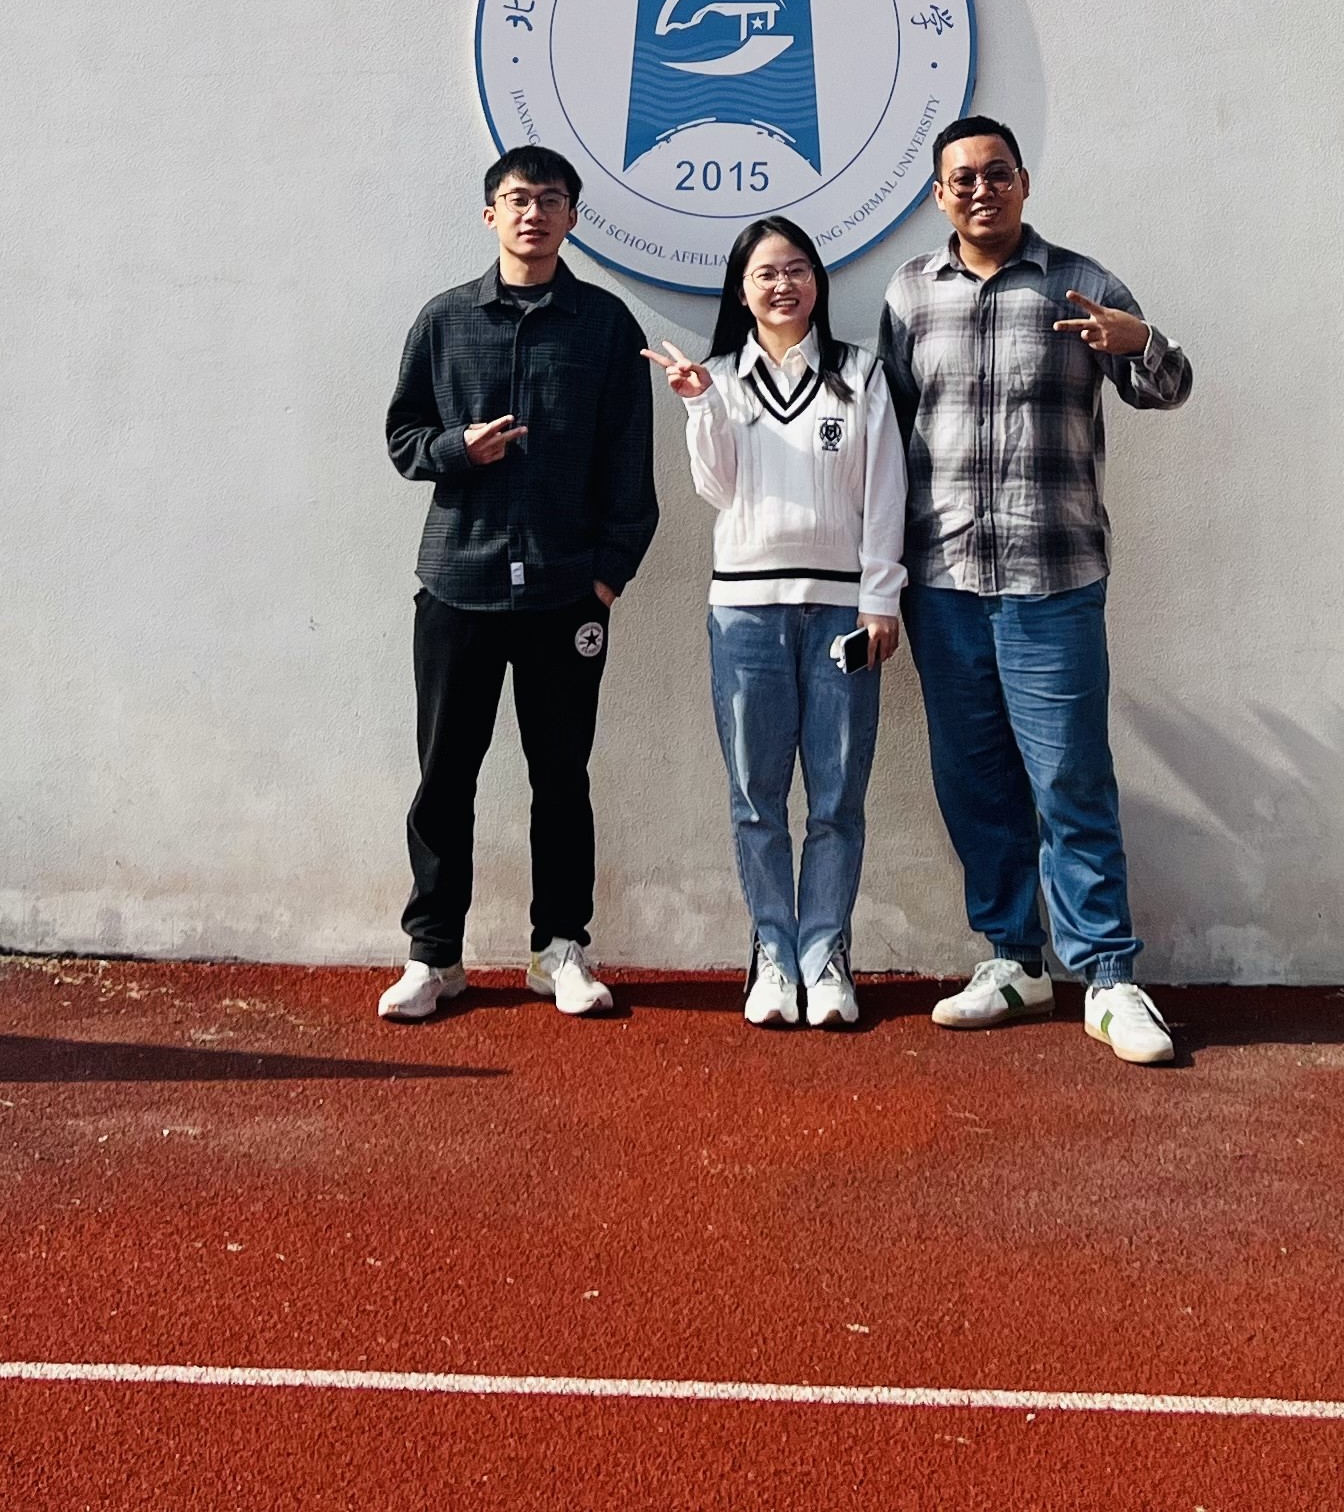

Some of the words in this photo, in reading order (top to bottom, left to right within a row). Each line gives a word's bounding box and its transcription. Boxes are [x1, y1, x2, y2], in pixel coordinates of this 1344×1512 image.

[509, 89, 541, 146] JIAXING
[606, 224, 666, 258] SCHOOL
[670, 249, 729, 267] AFFILIA
[843, 180, 898, 231] NORMAL
[892, 94, 941, 179] UNIVERSITY
[675, 160, 769, 191] 2015
